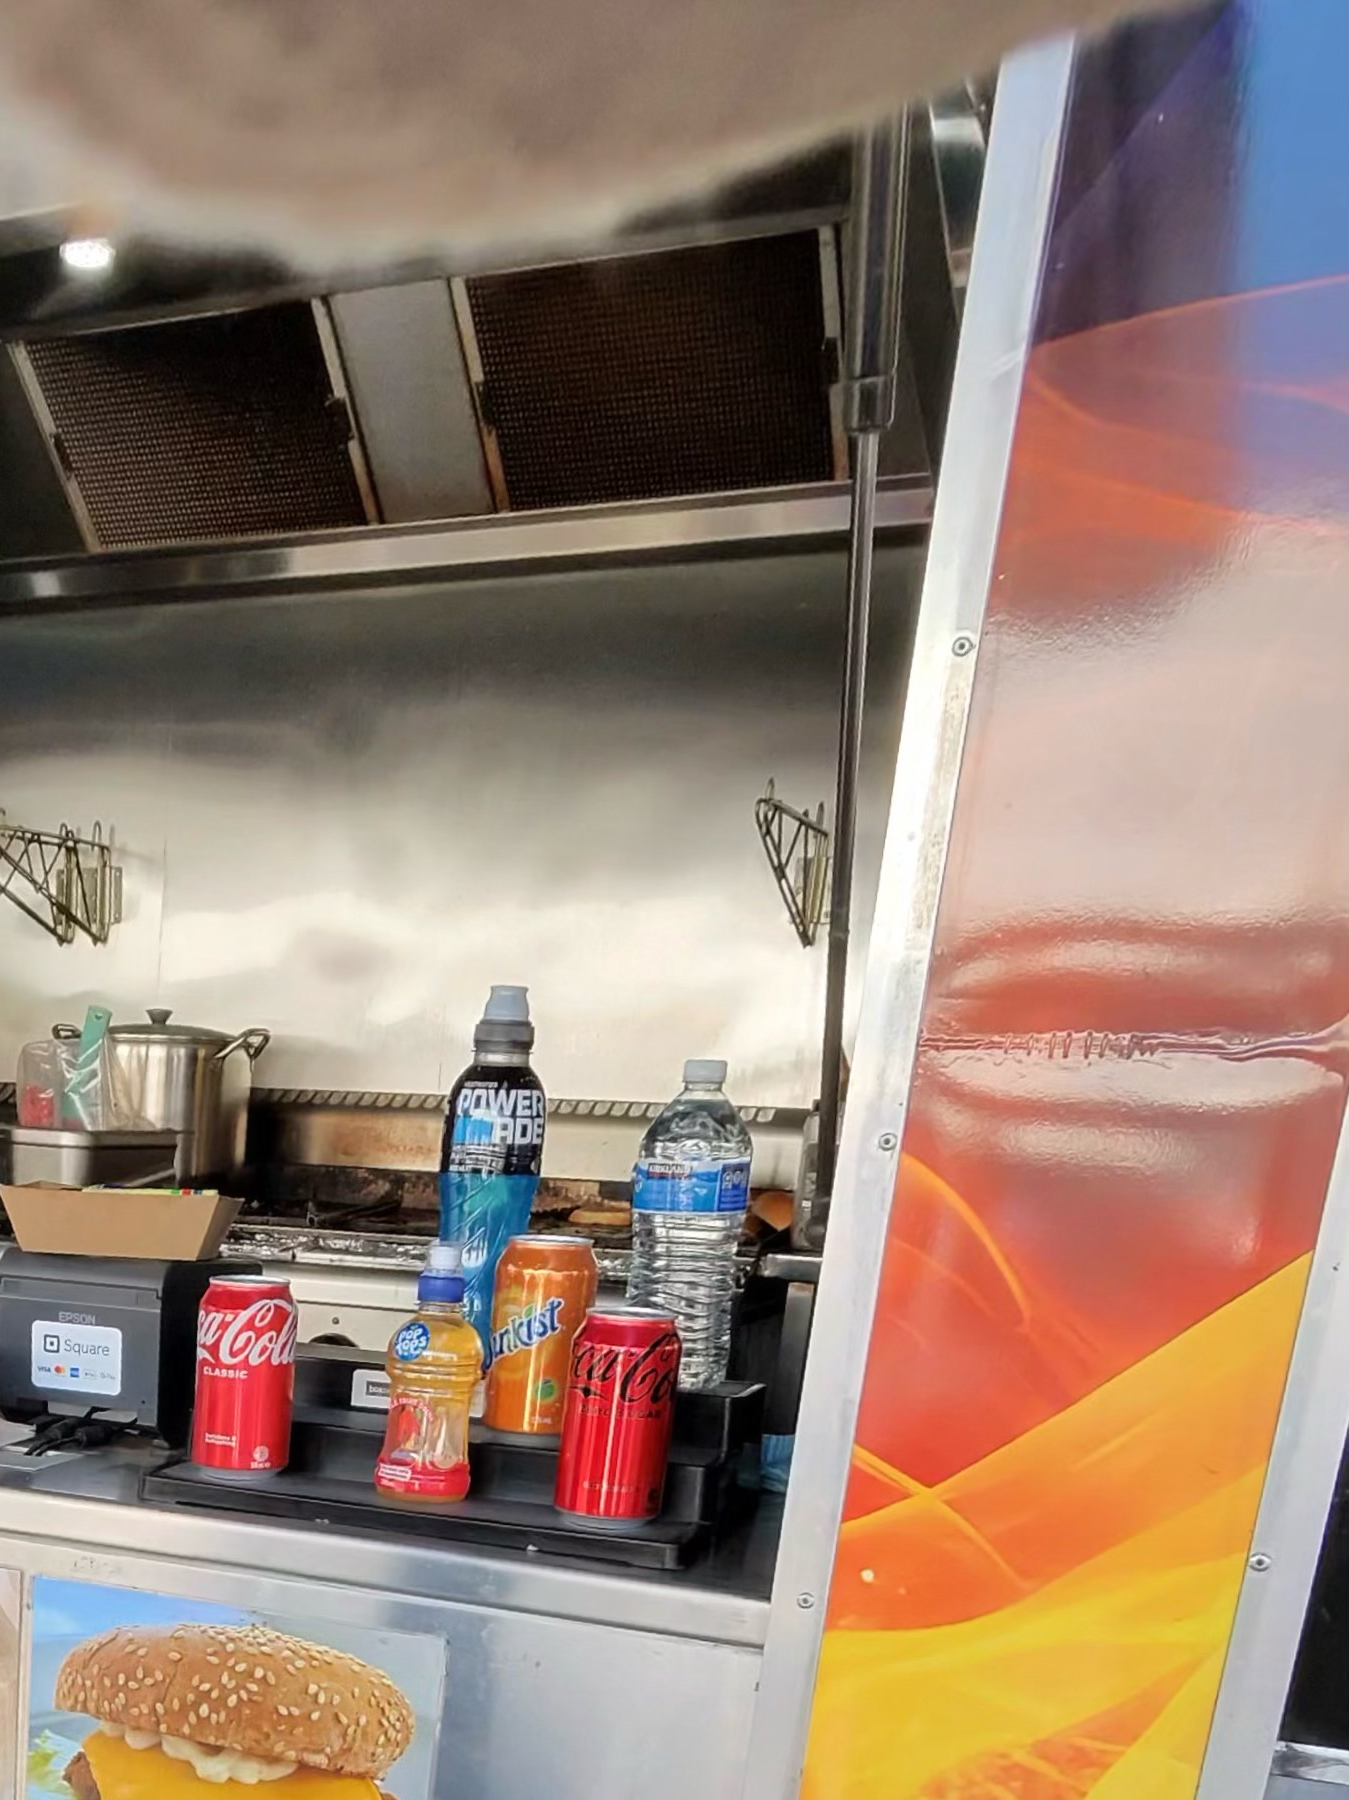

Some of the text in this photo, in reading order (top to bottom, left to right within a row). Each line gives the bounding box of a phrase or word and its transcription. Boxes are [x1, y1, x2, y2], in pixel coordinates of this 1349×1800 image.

[457, 1088, 544, 1116] POWER
[492, 1117, 543, 1145] ADE
[58, 1311, 96, 1325] EPSON
[63, 1339, 110, 1356] Square
[481, 1296, 565, 1380] unkist
[203, 1366, 248, 1379] CLASSIC
